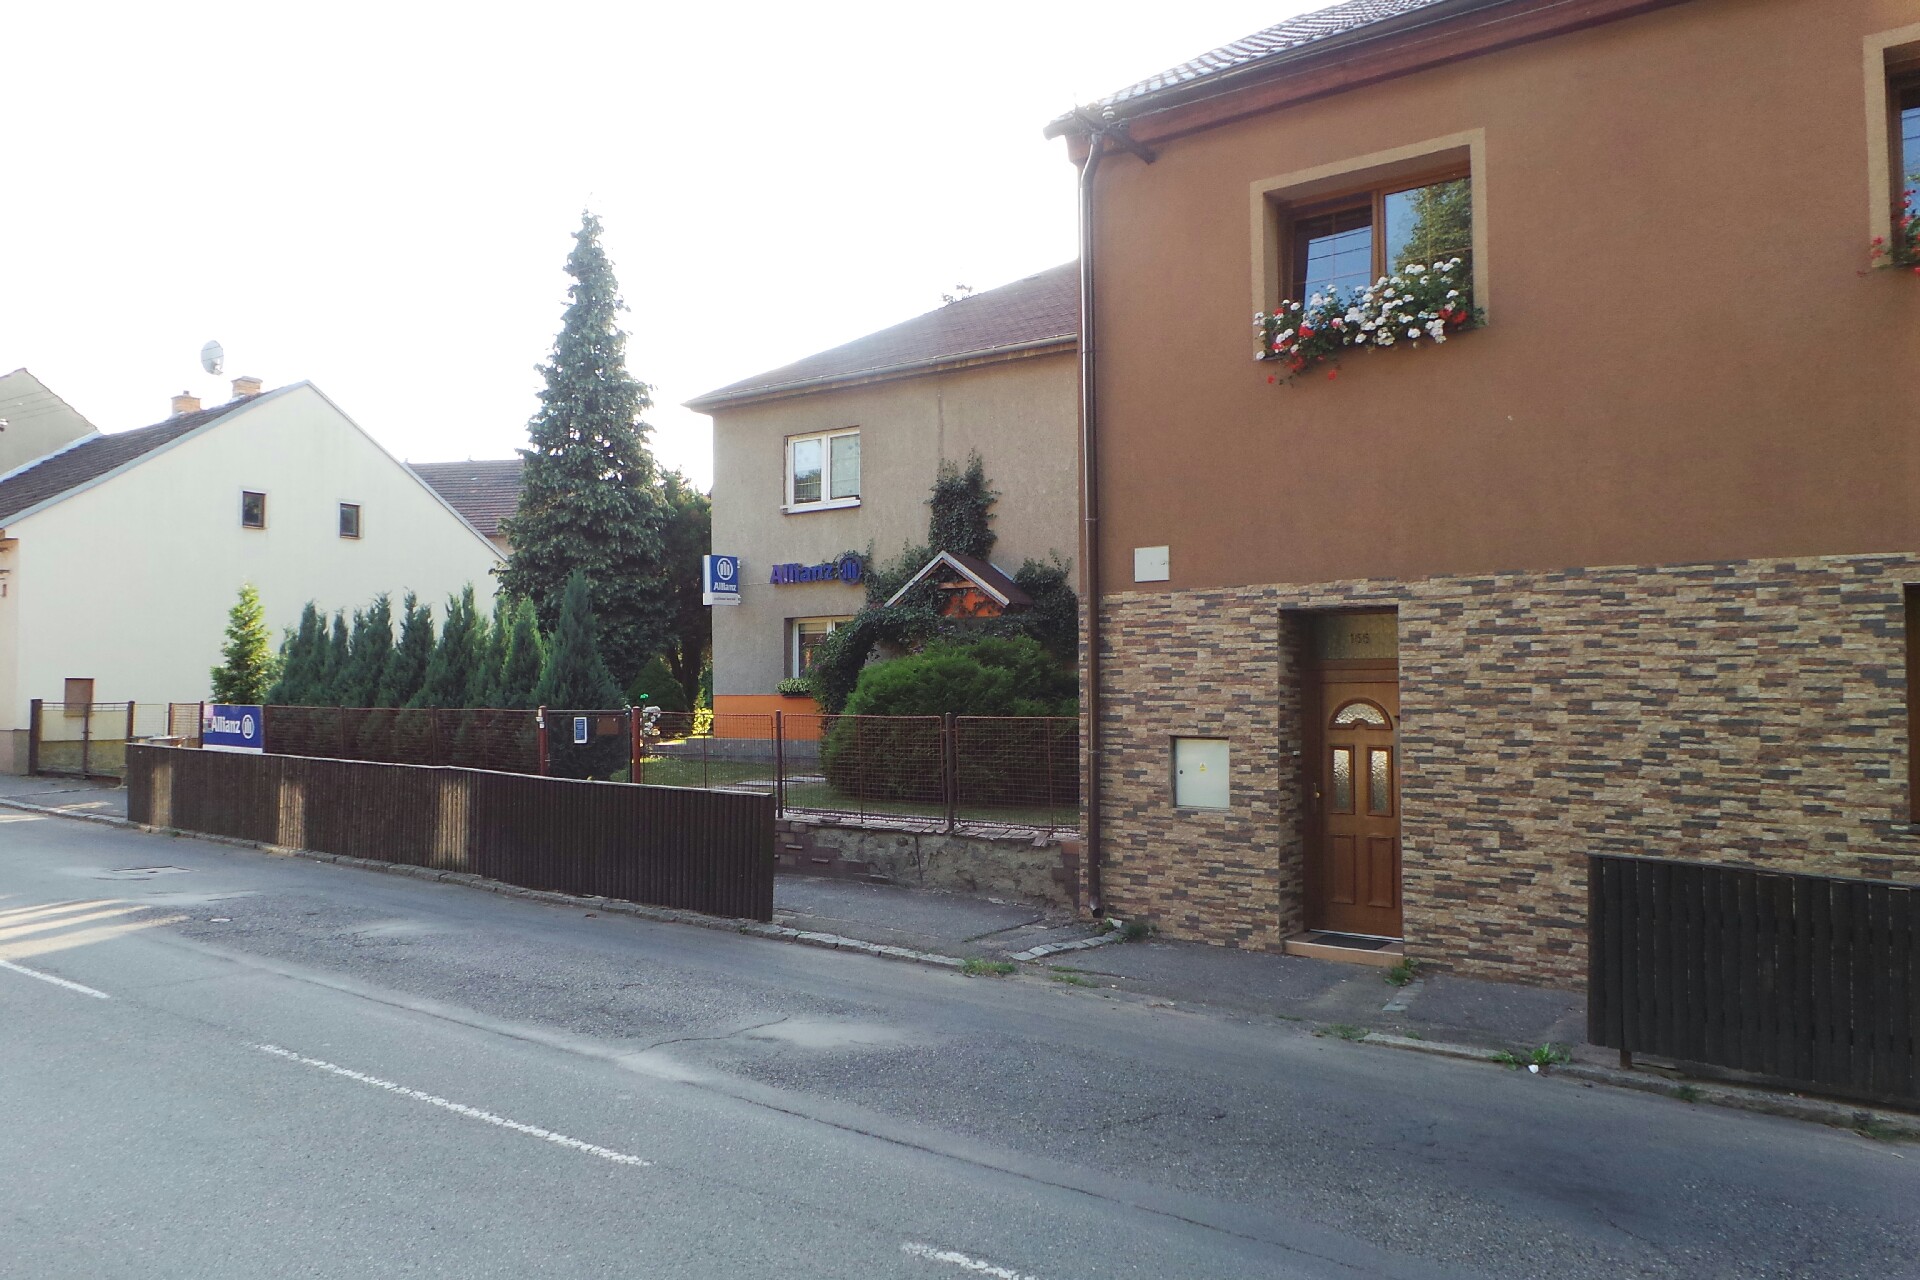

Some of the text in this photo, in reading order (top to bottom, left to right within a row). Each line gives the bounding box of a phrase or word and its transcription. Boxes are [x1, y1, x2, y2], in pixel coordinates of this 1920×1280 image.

[769, 563, 834, 584] Allianz
[713, 582, 737, 591] Allianz
[211, 716, 241, 734] Allianz
